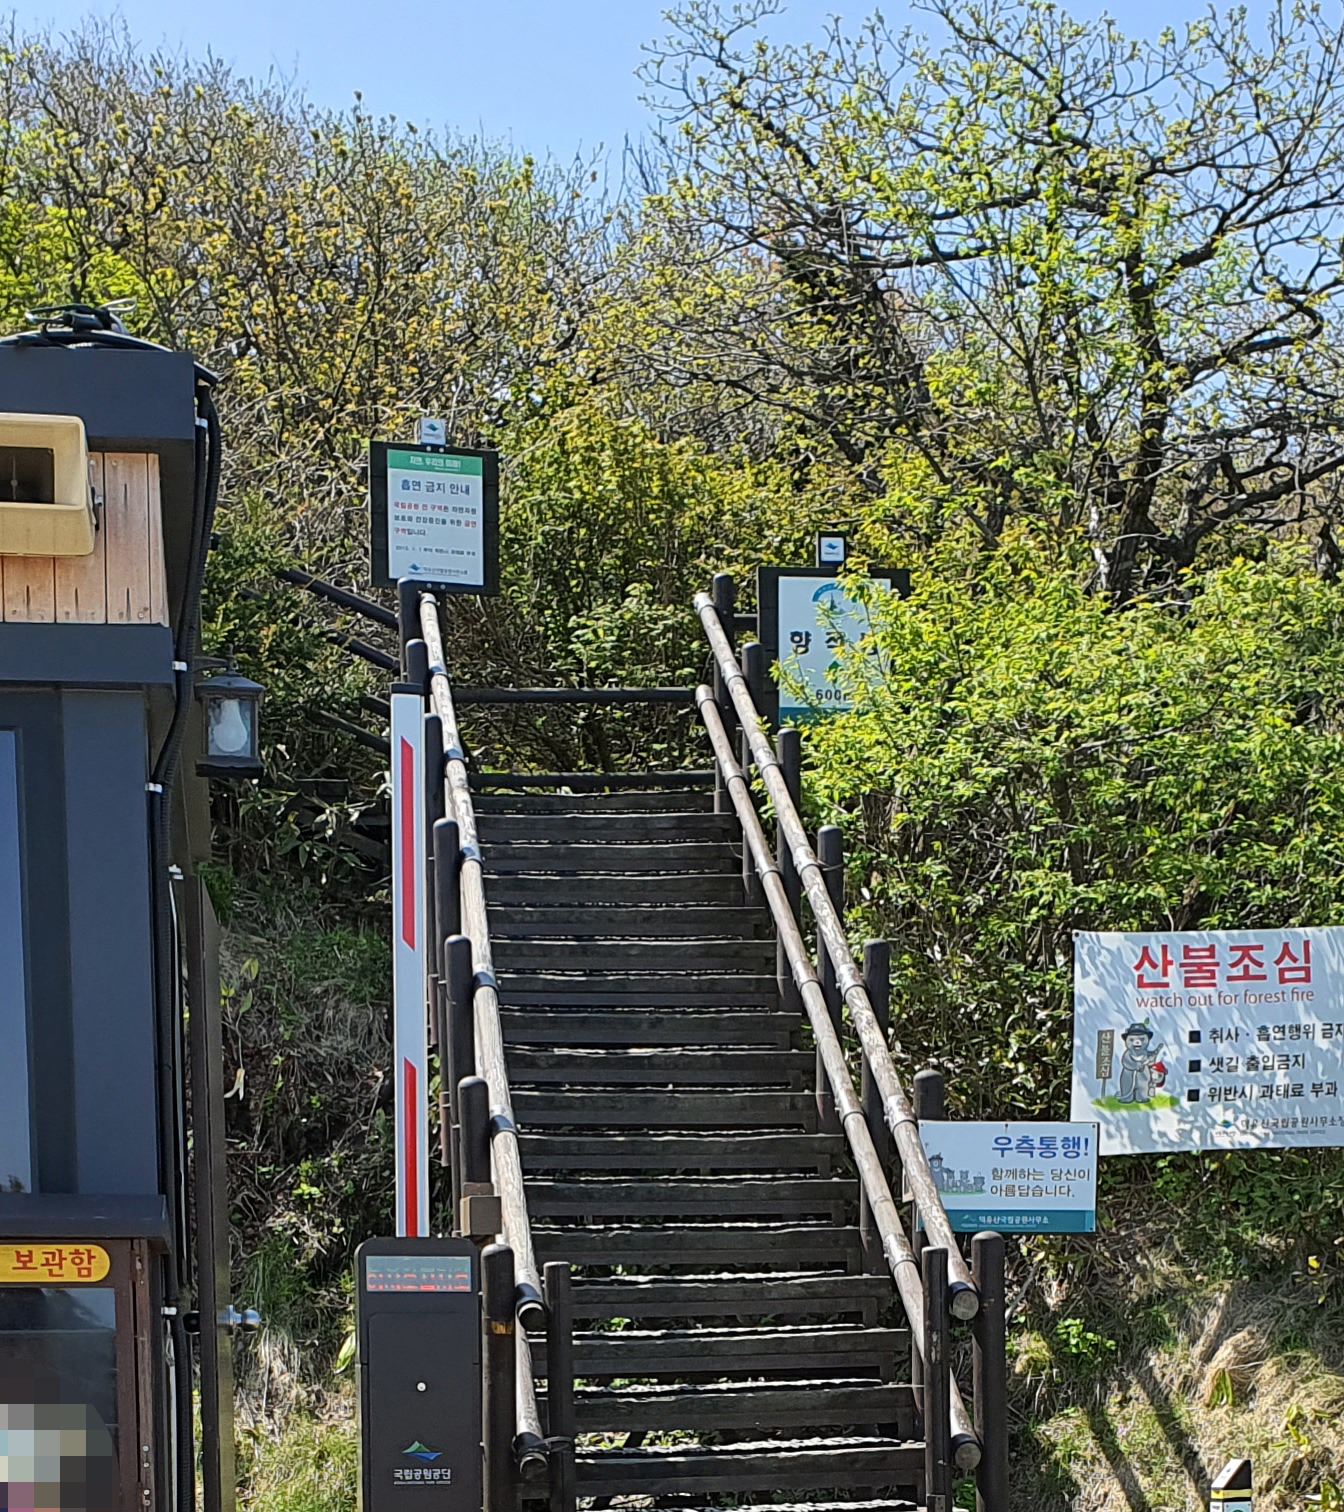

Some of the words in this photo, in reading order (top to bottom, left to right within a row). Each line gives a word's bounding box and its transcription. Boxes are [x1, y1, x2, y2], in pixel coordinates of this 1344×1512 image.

[401, 479, 421, 492] 흡연
[425, 481, 446, 494] 금지
[449, 483, 470, 496] 안내
[1133, 940, 1312, 989] 산불조심
[1136, 992, 1183, 1008] watch
[1188, 993, 1213, 1007] out
[1217, 990, 1239, 1006] for
[1243, 988, 1286, 1004] forest
[1290, 987, 1315, 1002] fire
[1209, 1026, 1239, 1044] 취사
[1256, 1022, 1316, 1042] 흡연행위
[1100, 1032, 1111, 1078] 산불조심
[1209, 1056, 1239, 1074] 샛길
[1245, 1052, 1305, 1072] 출입금지
[1207, 1084, 1253, 1102] 위반시
[1259, 1082, 1305, 1101] 과태료
[1310, 1081, 1338, 1098] 부과
[992, 1136, 1089, 1159] 우측통행!
[991, 1168, 1045, 1181] 함께하는
[1050, 1168, 1090, 1181] 당신이
[990, 1184, 1075, 1198] 아름답습니다.
[979, 1216, 1049, 1225] 덕유산국립공원사무소
[12, 1248, 97, 1278] 보관함
[394, 1469, 451, 1480] 국립공원공단
